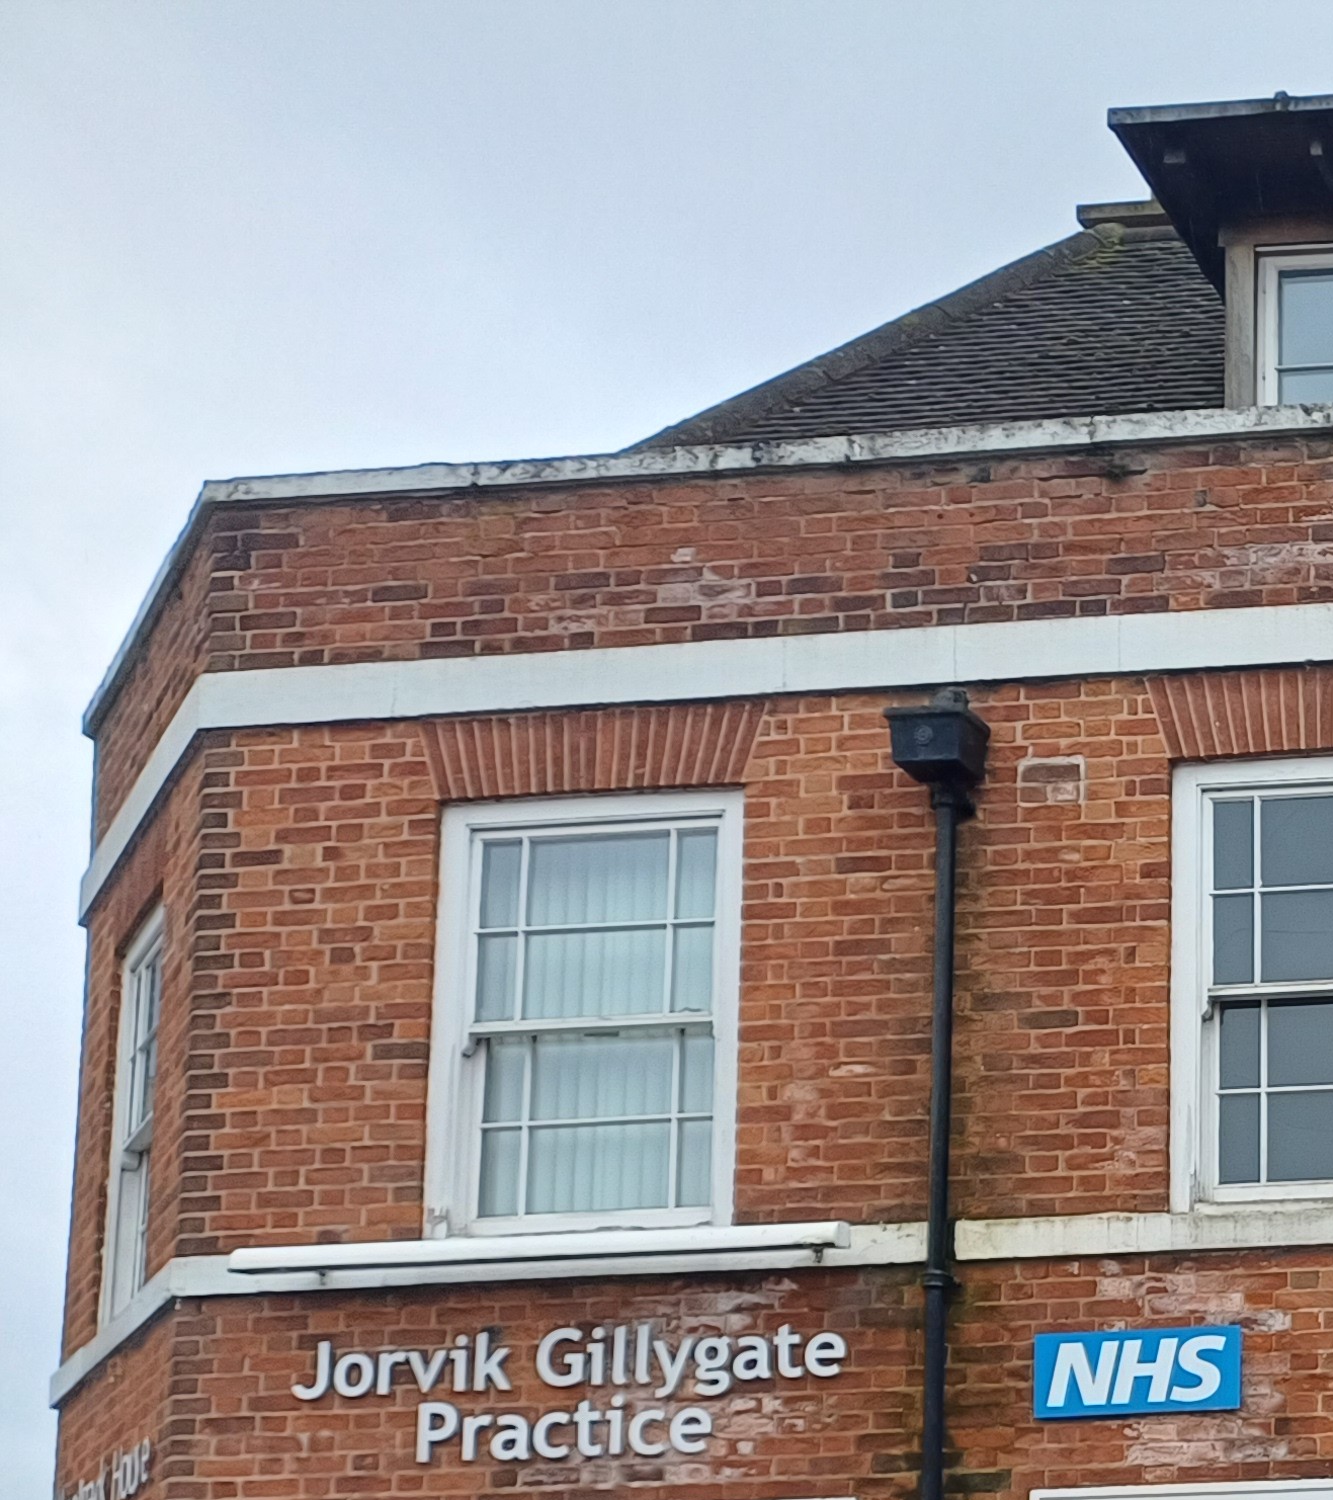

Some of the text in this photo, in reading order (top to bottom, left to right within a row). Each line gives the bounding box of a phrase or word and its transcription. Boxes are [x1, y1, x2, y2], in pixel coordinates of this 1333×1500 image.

[292, 1324, 846, 1400] Jorvik Gillygate
[1046, 1335, 1226, 1407] NHS
[415, 1396, 713, 1464] Practice
